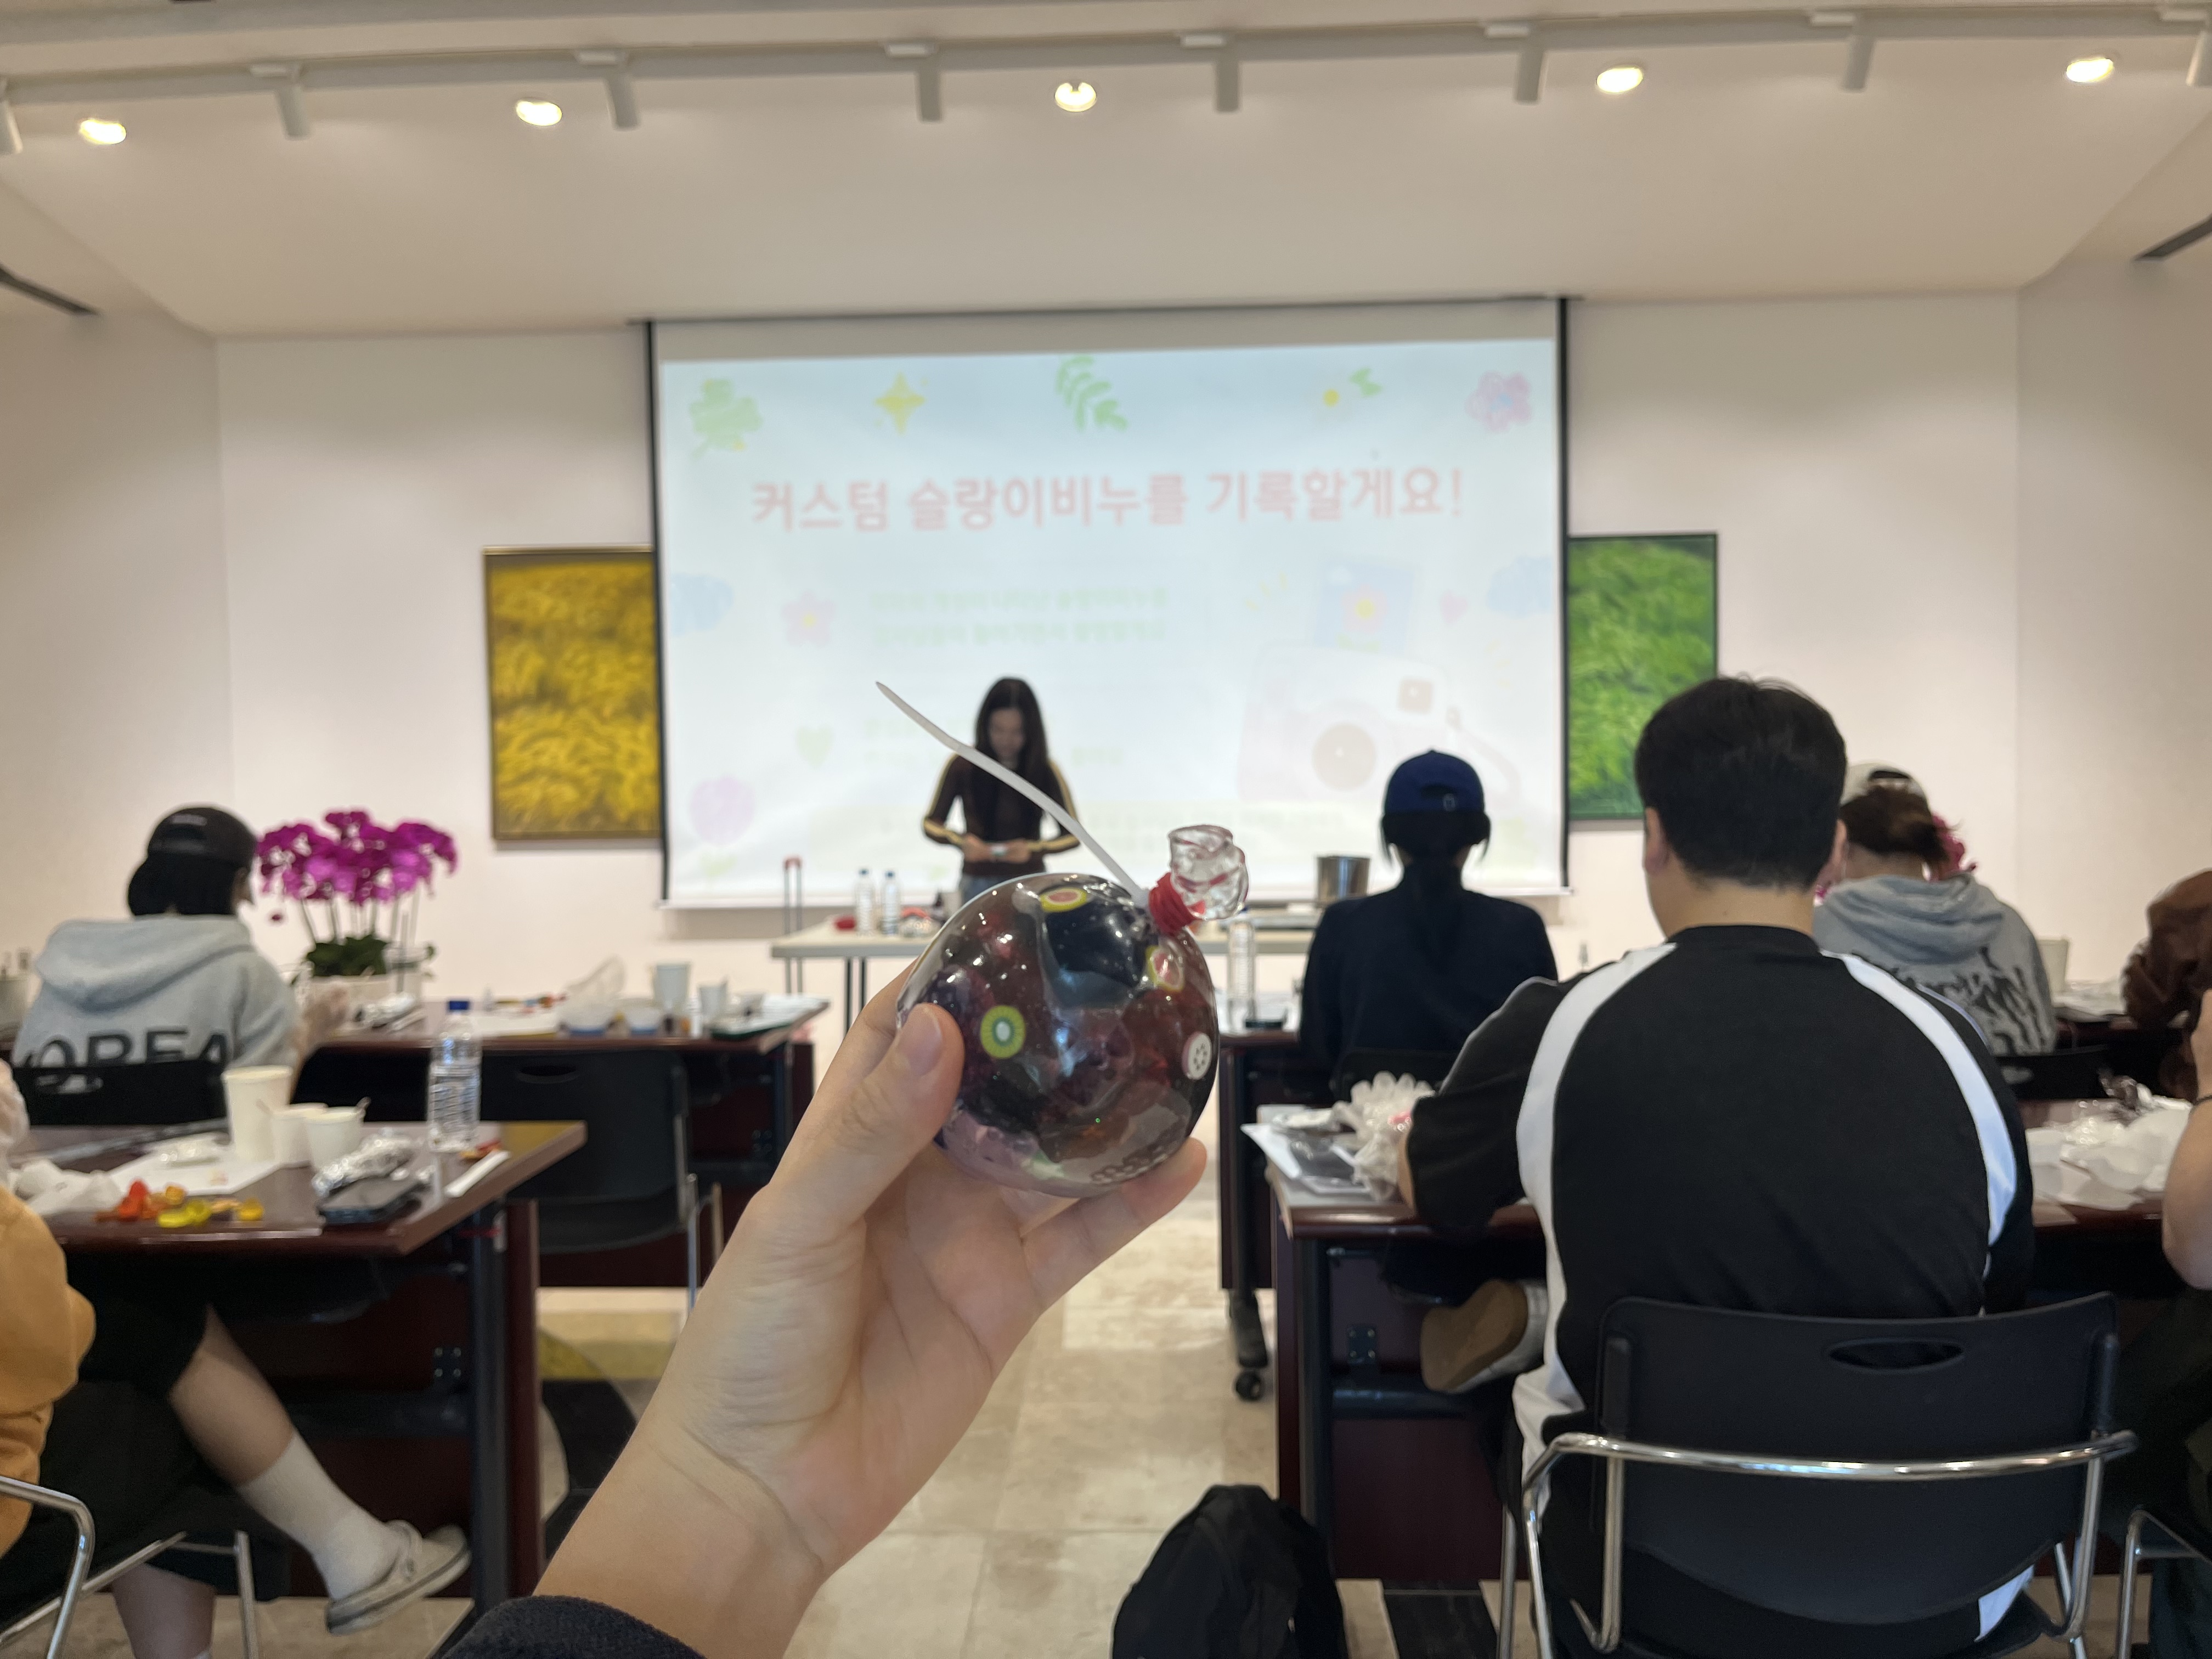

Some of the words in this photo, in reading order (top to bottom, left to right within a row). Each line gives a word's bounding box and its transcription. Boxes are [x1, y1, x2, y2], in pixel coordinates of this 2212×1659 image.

[751, 481, 889, 533] 커스텀
[907, 472, 1188, 531] 슬랑이비누를
[1206, 465, 1464, 522] 기록할게요!
